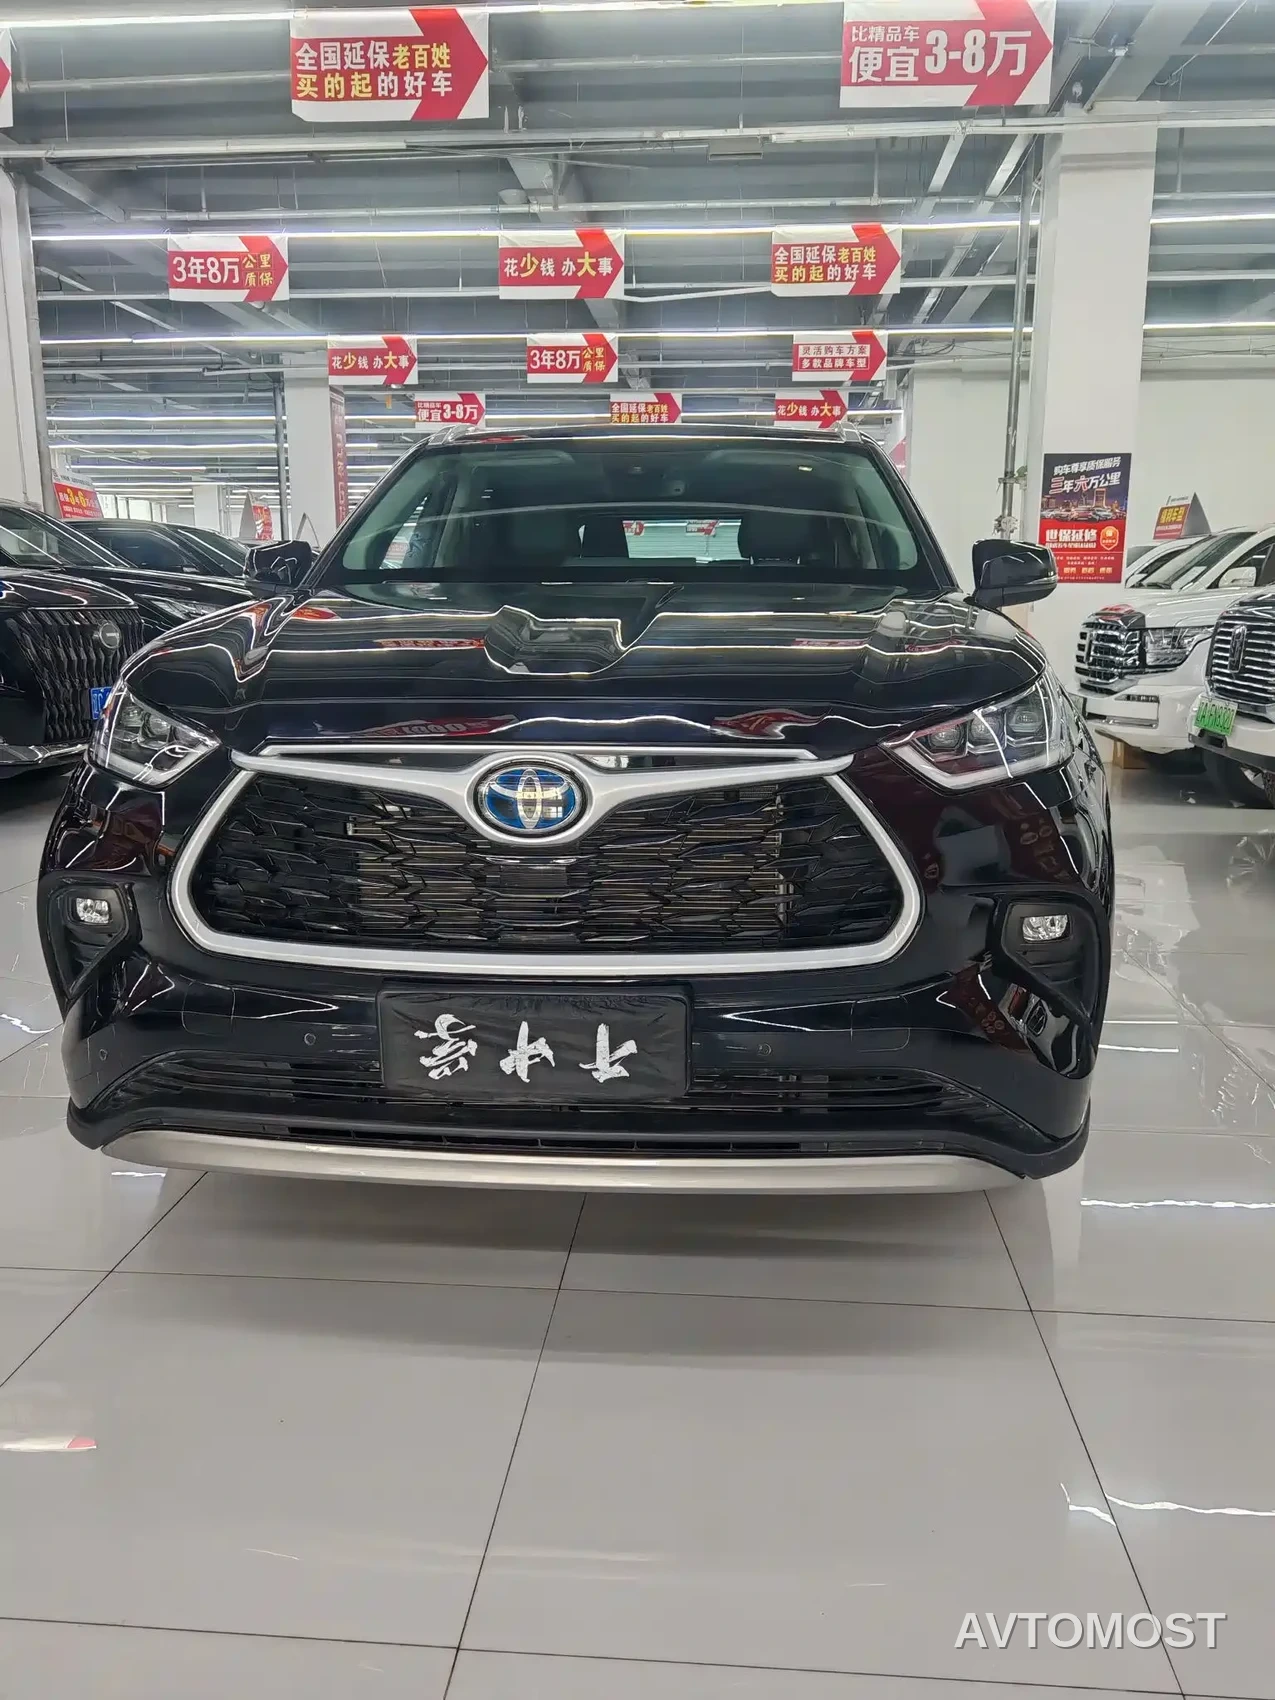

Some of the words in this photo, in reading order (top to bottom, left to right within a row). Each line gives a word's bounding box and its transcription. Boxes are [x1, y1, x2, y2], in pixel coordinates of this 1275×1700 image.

[850, 26, 921, 43] 比精品车
[294, 41, 452, 70] 全国延保老百姓
[296, 72, 453, 98] 买的起的好车
[242, 253, 272, 269] 公里
[774, 245, 877, 264] 全国延保老百姓
[172, 256, 240, 284] 3年8万
[503, 253, 555, 278] 花少钱
[561, 251, 613, 277] 办大事
[244, 271, 274, 287] 质保
[774, 265, 877, 283] 买的起的好车
[530, 349, 581, 370] 3年8万
[802, 345, 867, 356] 灵活购车方案
[331, 352, 369, 370] 花少钱
[372, 350, 410, 369] 办大事
[802, 358, 867, 369] 多款品牌车型
[611, 403, 668, 414] 全国延保老百姓
[777, 402, 808, 417] 花少钱
[811, 402, 842, 417] 办大事
[611, 414, 669, 424] 买的起的好车
[1053, 456, 1122, 476] 购车尊享质保服务
[1049, 472, 1121, 494] 三年六万公里
[1045, 528, 1097, 542] 世保延修
